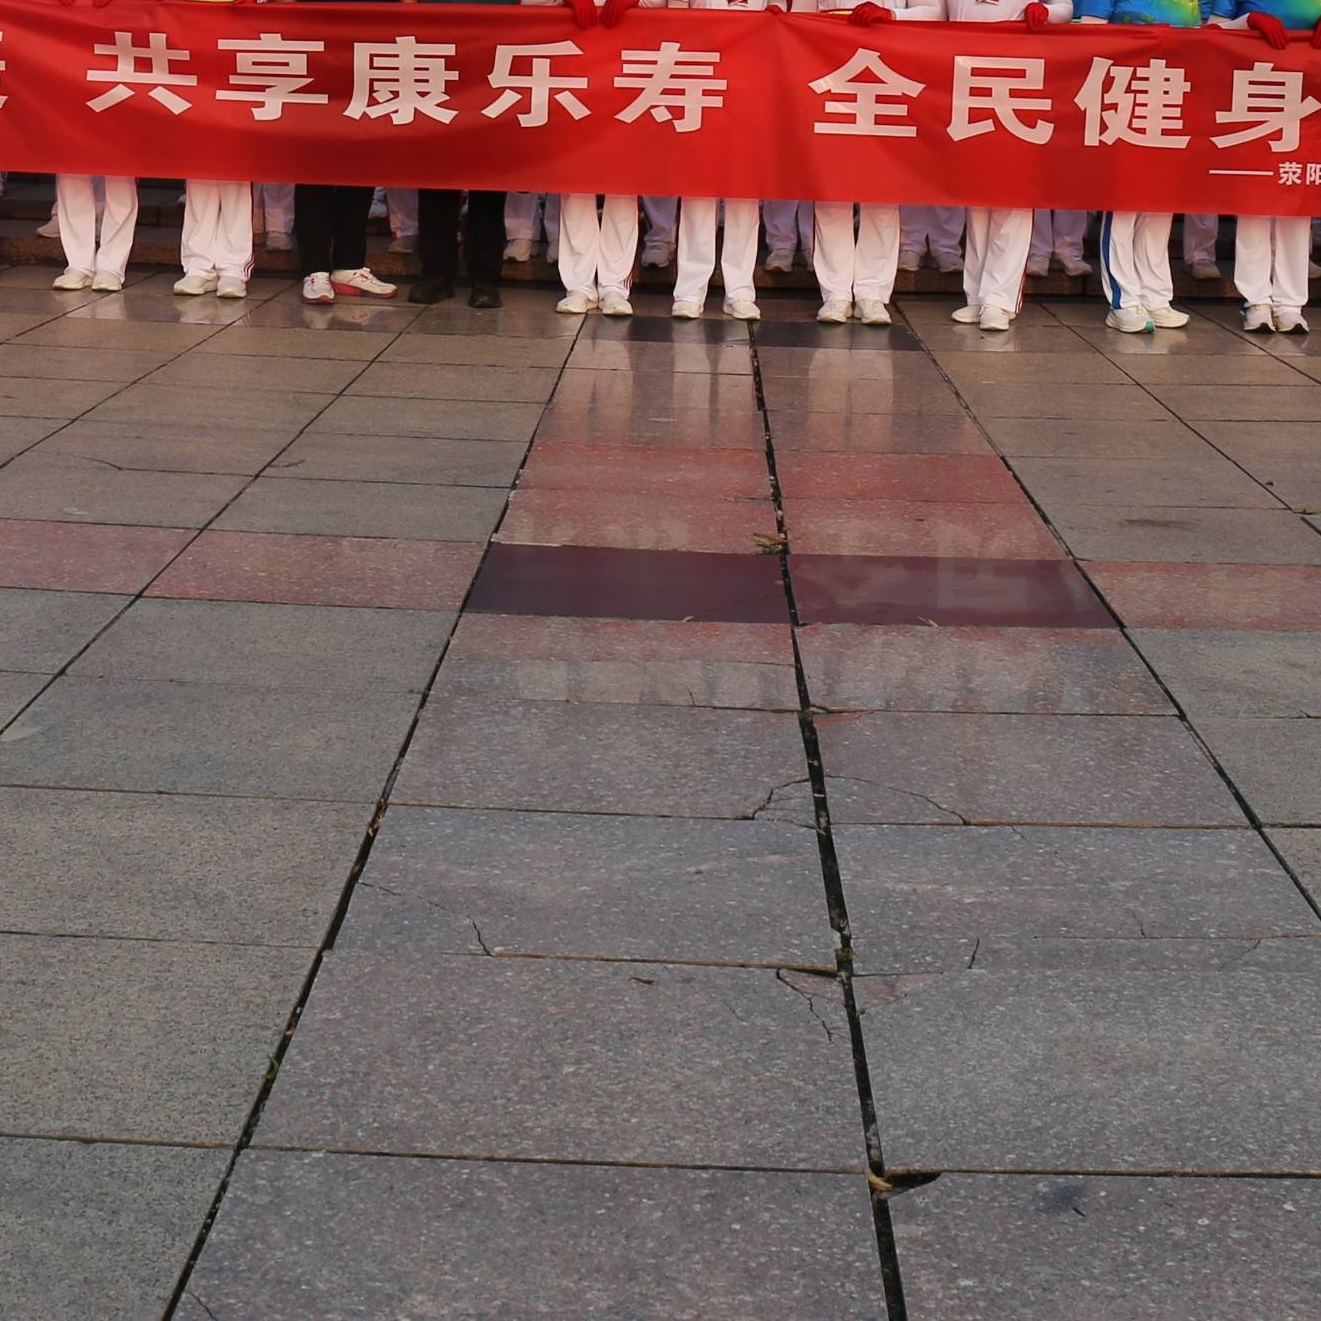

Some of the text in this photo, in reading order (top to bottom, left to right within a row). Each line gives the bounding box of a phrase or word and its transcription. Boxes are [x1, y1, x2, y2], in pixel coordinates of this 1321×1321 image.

[85, 31, 729, 134] 共享康乐寿
